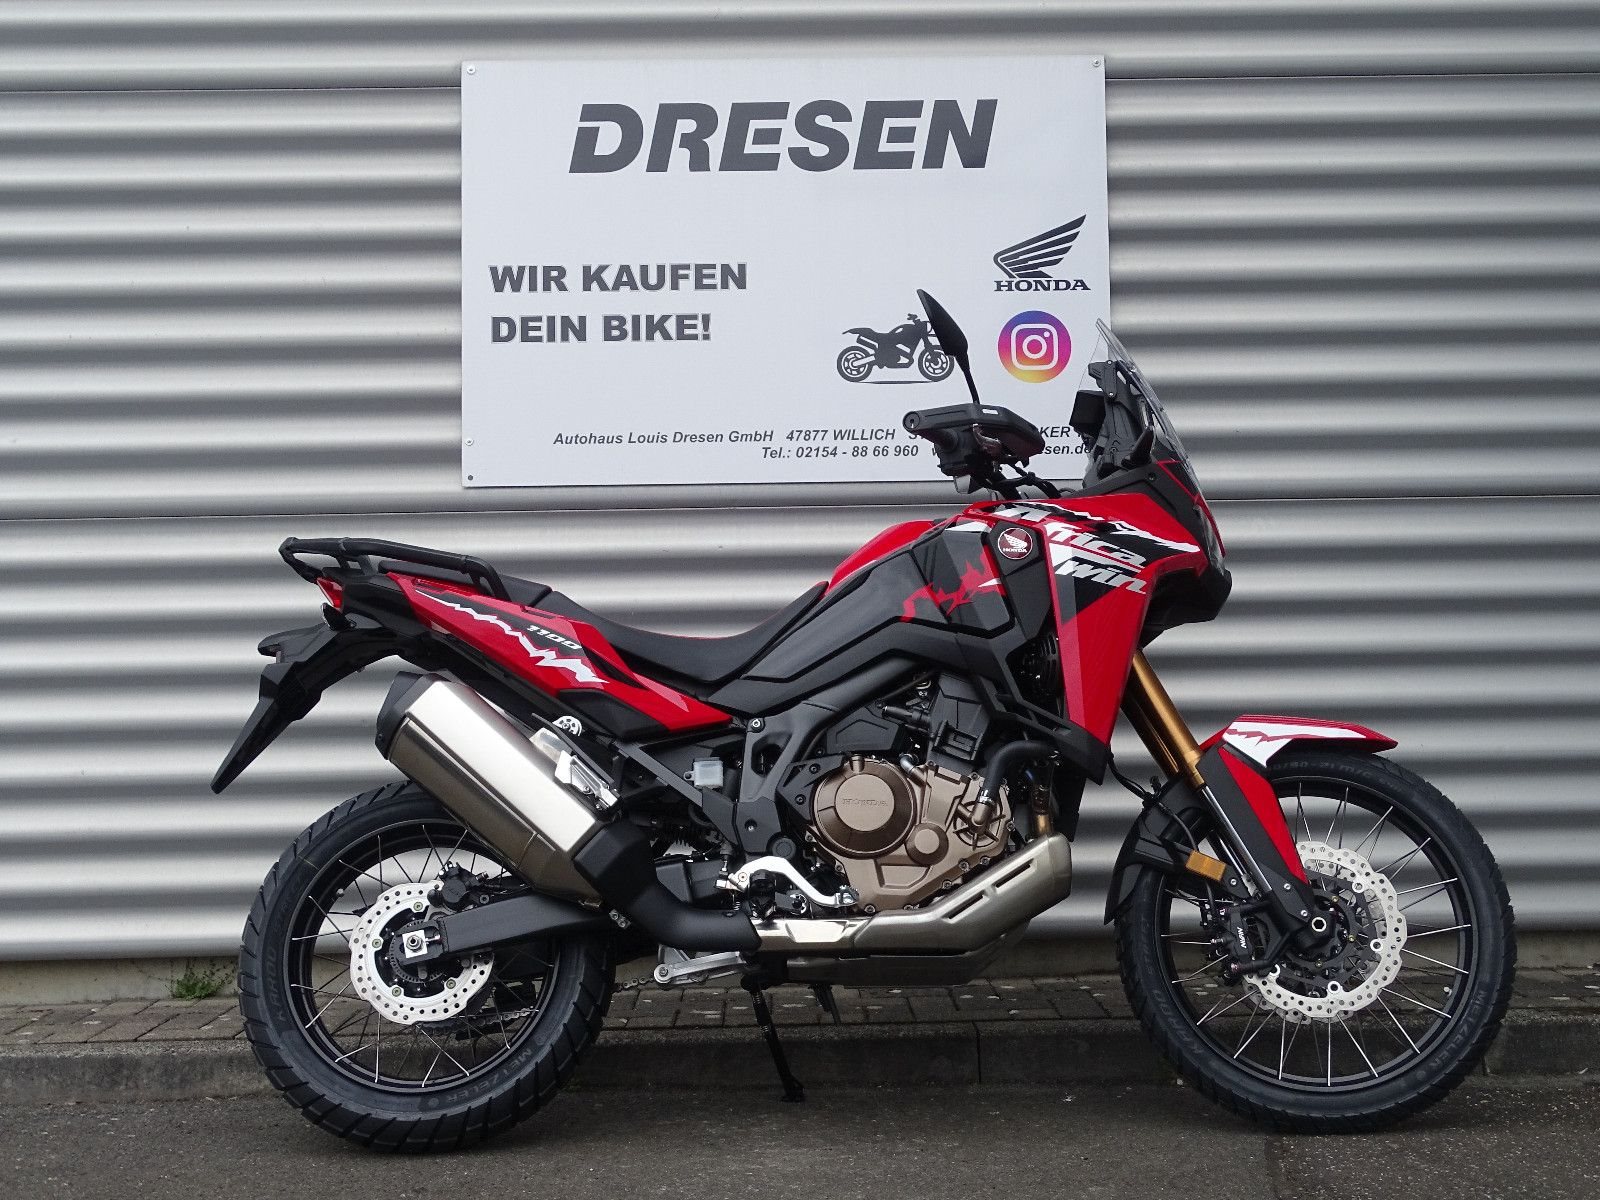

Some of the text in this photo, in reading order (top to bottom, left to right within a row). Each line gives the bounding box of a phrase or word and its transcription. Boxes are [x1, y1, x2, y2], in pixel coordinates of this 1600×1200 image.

[569, 99, 998, 173] DRESEN
[489, 263, 747, 293] WIR KAUFEN
[994, 279, 1091, 292] HONDA
[491, 313, 711, 343] DEIN BIKE!
[553, 432, 624, 445] Autohaus
[627, 431, 668, 444] Louis
[672, 431, 724, 443] Dresen
[728, 430, 774, 443] GmbH
[785, 429, 829, 442] 47877
[833, 428, 896, 441] WILLICH
[761, 446, 791, 459] Tel.:
[795, 446, 838, 459] 02154
[851, 446, 869, 458] 88
[872, 445, 890, 457] 66
[893, 444, 919, 457] 960
[527, 625, 583, 649] 1100
